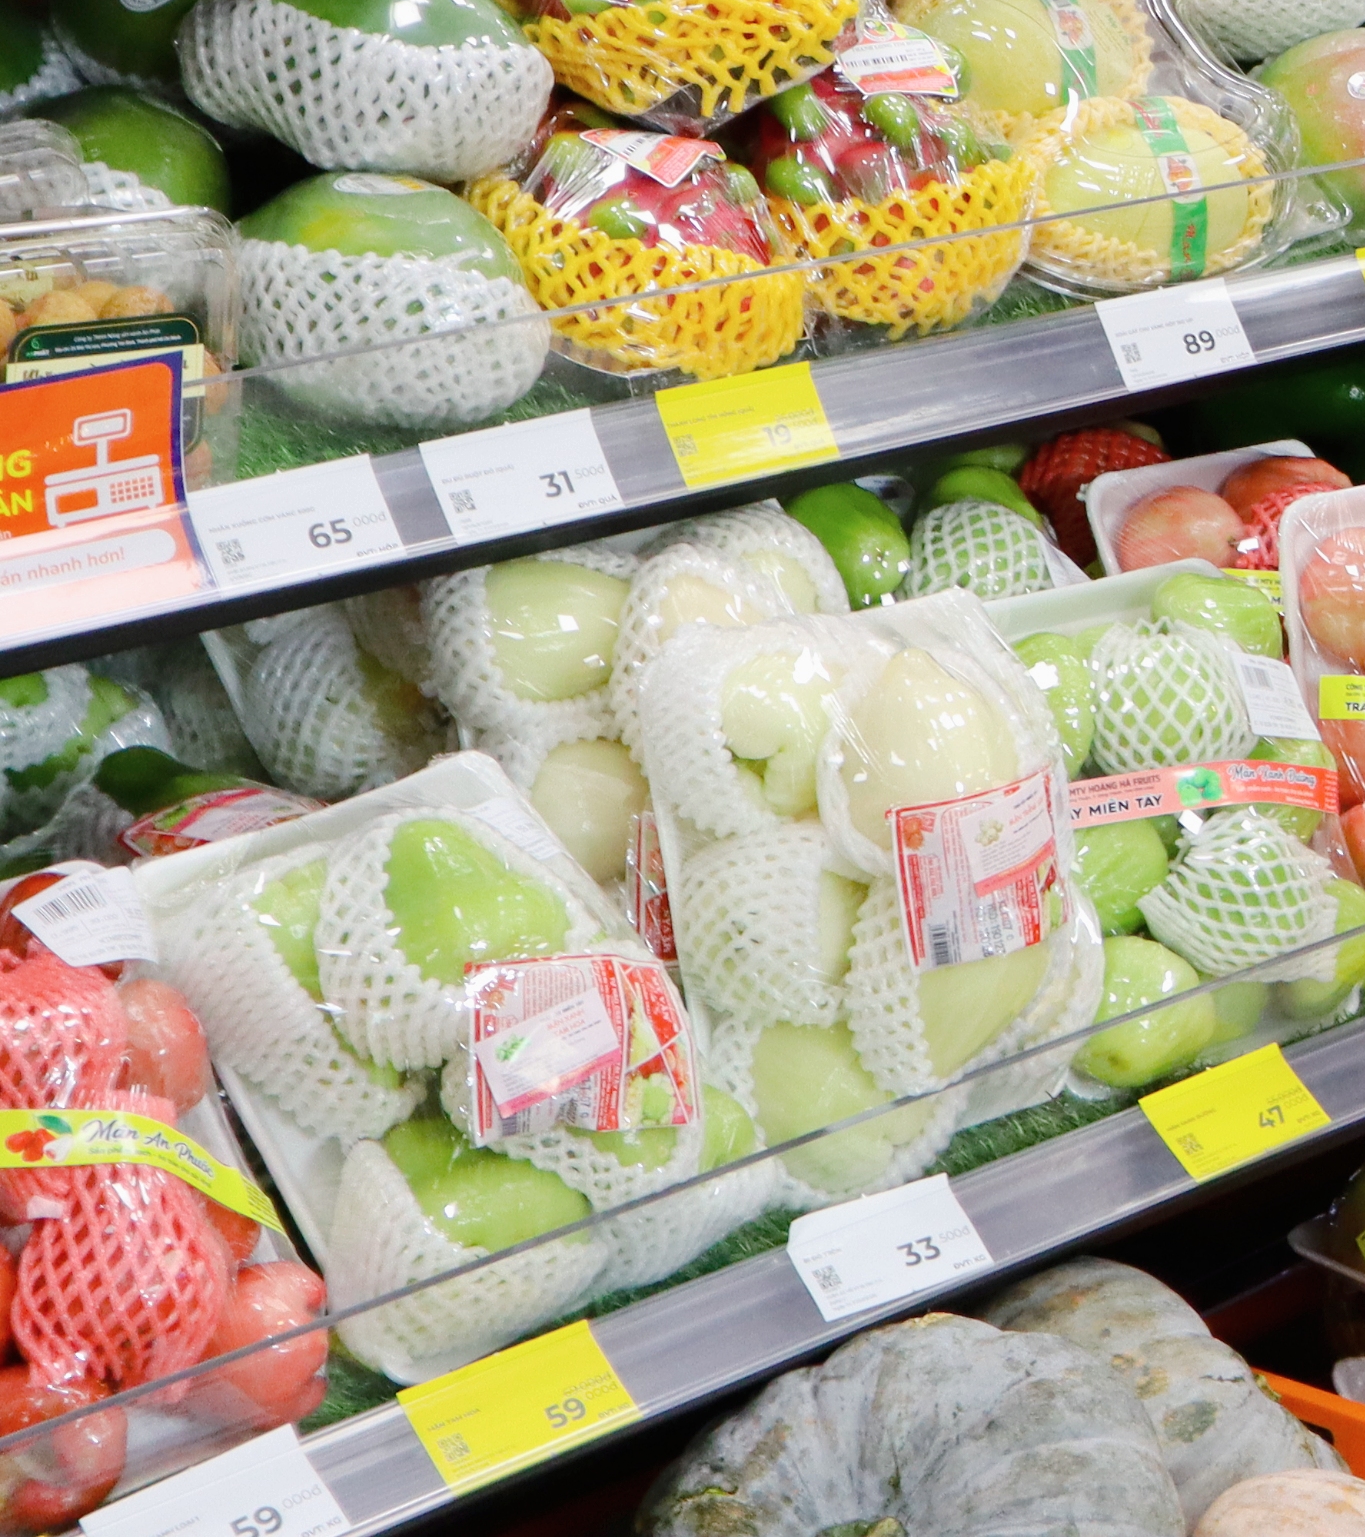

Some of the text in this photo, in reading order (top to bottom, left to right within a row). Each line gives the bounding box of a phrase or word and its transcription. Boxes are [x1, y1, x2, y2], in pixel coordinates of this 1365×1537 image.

[1184, 330, 1215, 354] 89
[763, 424, 793, 448] 19
[539, 470, 576, 498] 31
[309, 519, 353, 550] 65
[27, 552, 83, 580] nhanh
[88, 545, 126, 569] hơn!
[1133, 774, 1161, 786] FRUITS
[1259, 1105, 1285, 1129] 47
[143, 1130, 171, 1150] An
[897, 1235, 942, 1267] 33
[544, 1397, 587, 1430] 59
[229, 1504, 284, 1537] 59
